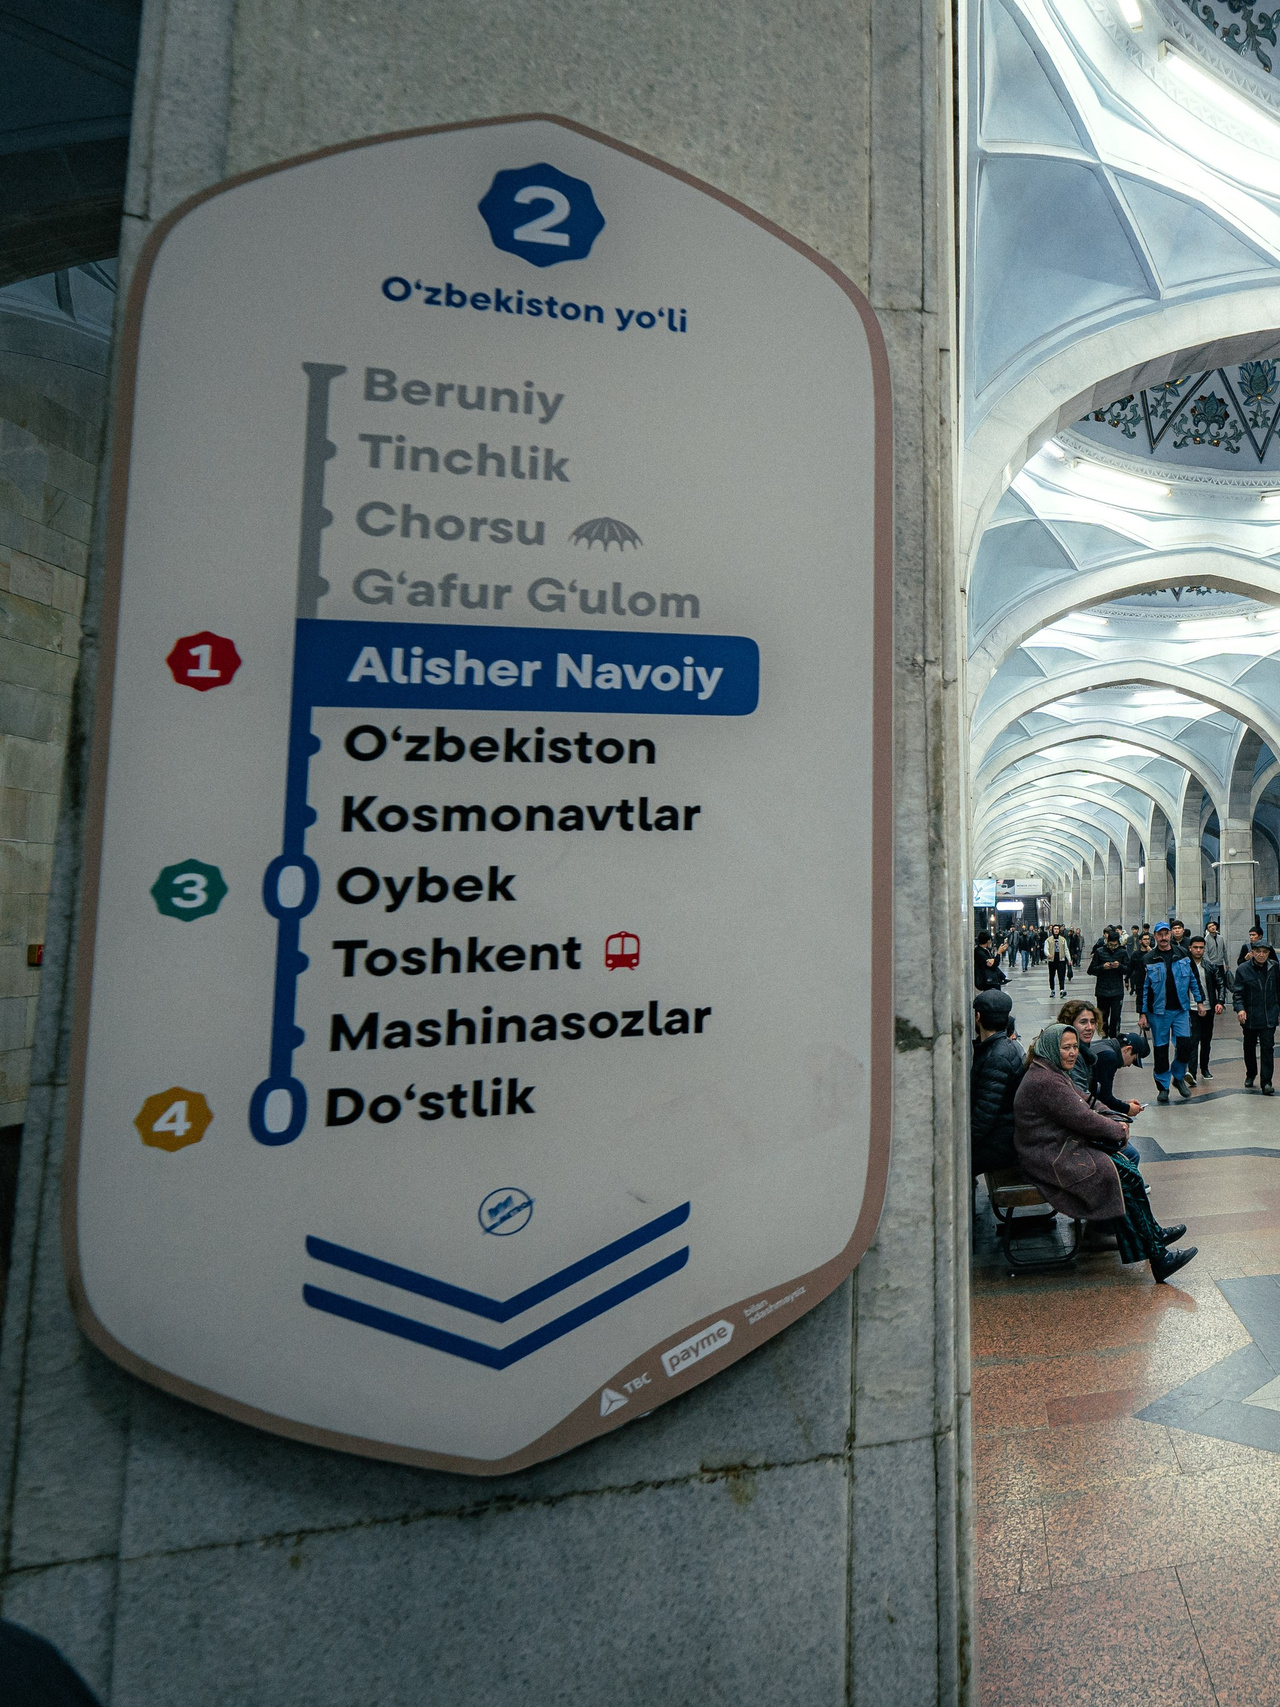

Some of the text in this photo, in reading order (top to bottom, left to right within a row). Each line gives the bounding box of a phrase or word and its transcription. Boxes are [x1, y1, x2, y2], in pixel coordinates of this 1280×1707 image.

[513, 185, 571, 247] 2
[362, 365, 564, 425] Beruniy
[357, 432, 569, 482] Tinchlik
[355, 500, 545, 546] Chorsu
[187, 644, 221, 678] 1
[347, 646, 724, 701] Alisher Navoiy
[341, 795, 702, 833] Kosmonavtlar
[171, 872, 208, 909] 3
[336, 865, 515, 914] Oybek
[332, 936, 582, 978] Toshkent
[329, 1000, 712, 1053] Mashinasozlar
[153, 1099, 193, 1138] 4
[668, 1326, 728, 1372] payme
[622, 1372, 653, 1394] TBC
